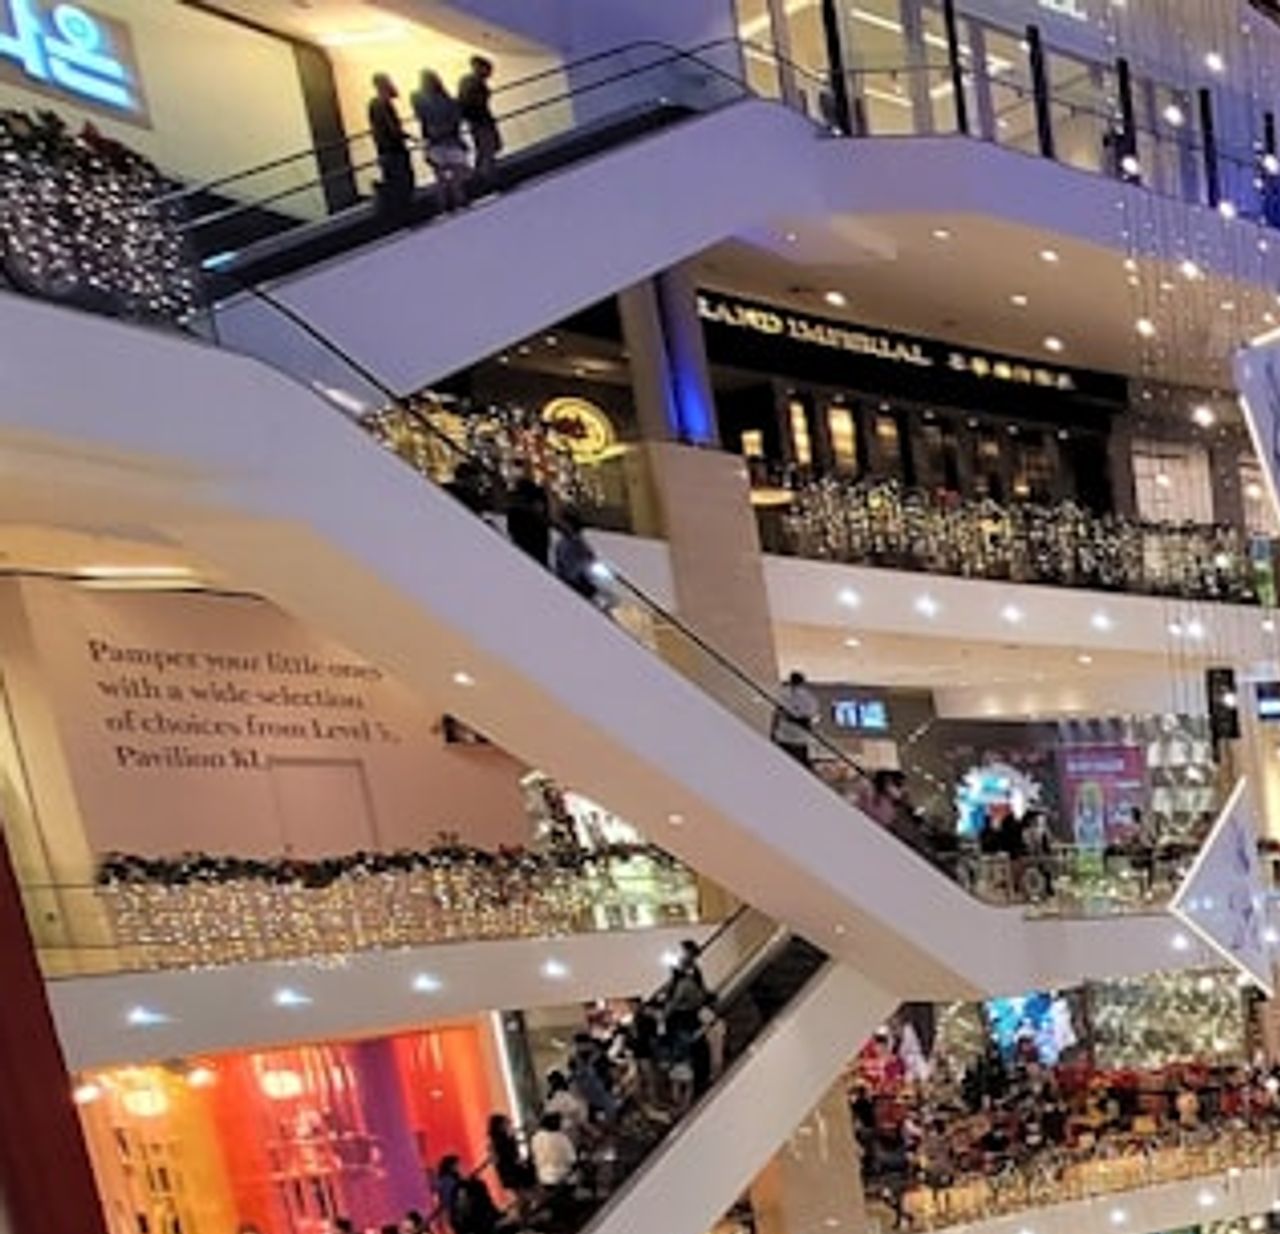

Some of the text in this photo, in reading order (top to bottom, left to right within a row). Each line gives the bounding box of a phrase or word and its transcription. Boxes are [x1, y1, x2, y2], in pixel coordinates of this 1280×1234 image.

[87, 639, 382, 681] Pamper your little ones
[97, 676, 363, 709] with a wide selection
[105, 710, 136, 733] of
[141, 712, 242, 737] choices
[246, 713, 306, 739] from
[311, 717, 371, 742] Level
[115, 745, 226, 769] Pavilion
